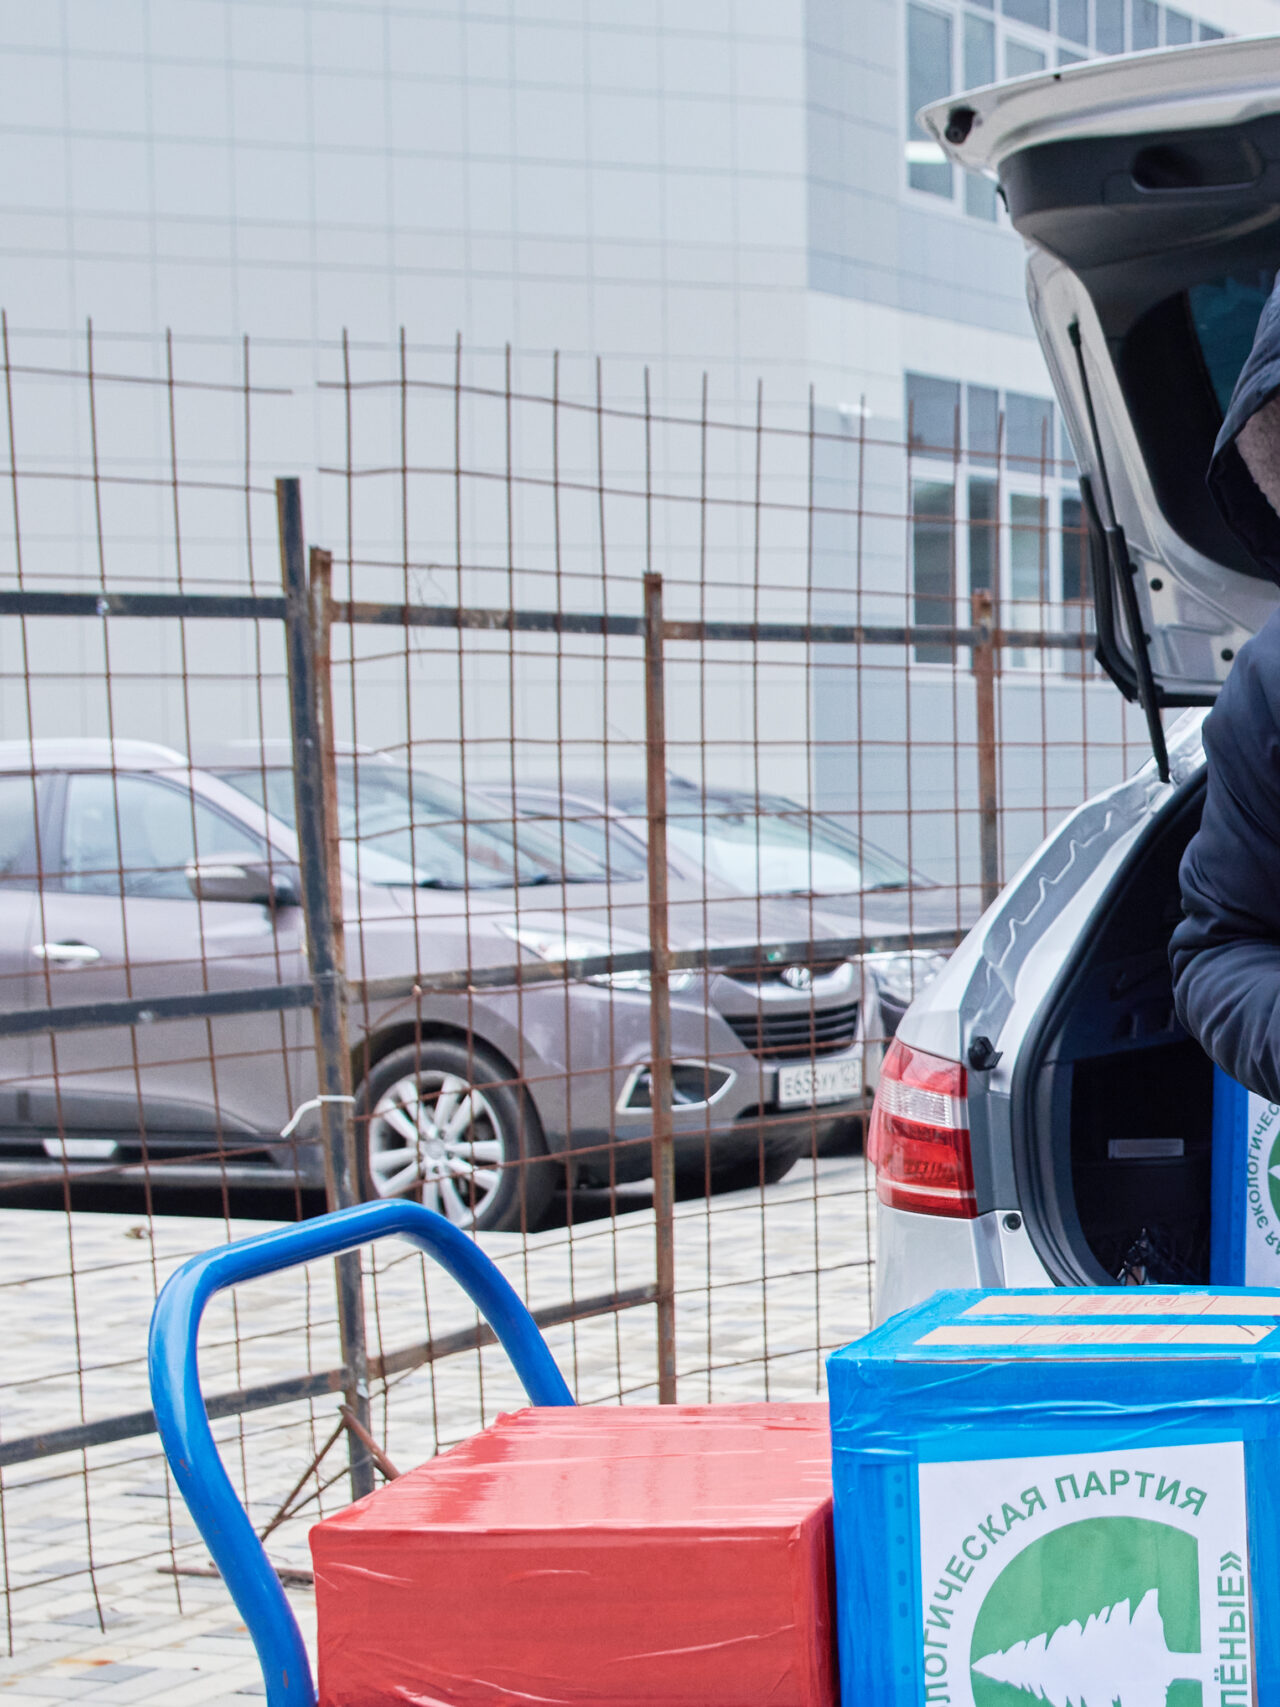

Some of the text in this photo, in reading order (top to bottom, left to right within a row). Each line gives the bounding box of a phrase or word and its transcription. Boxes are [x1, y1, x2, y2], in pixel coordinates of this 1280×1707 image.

[1247, 1102, 1280, 1229] ЭКОЛОГИЧЕС
[924, 1469, 1207, 1707] ЛОГИЧЕСКАЯ ПАРТИЯ
[1214, 1551, 1248, 1707] ЛЁНЫЕ»
